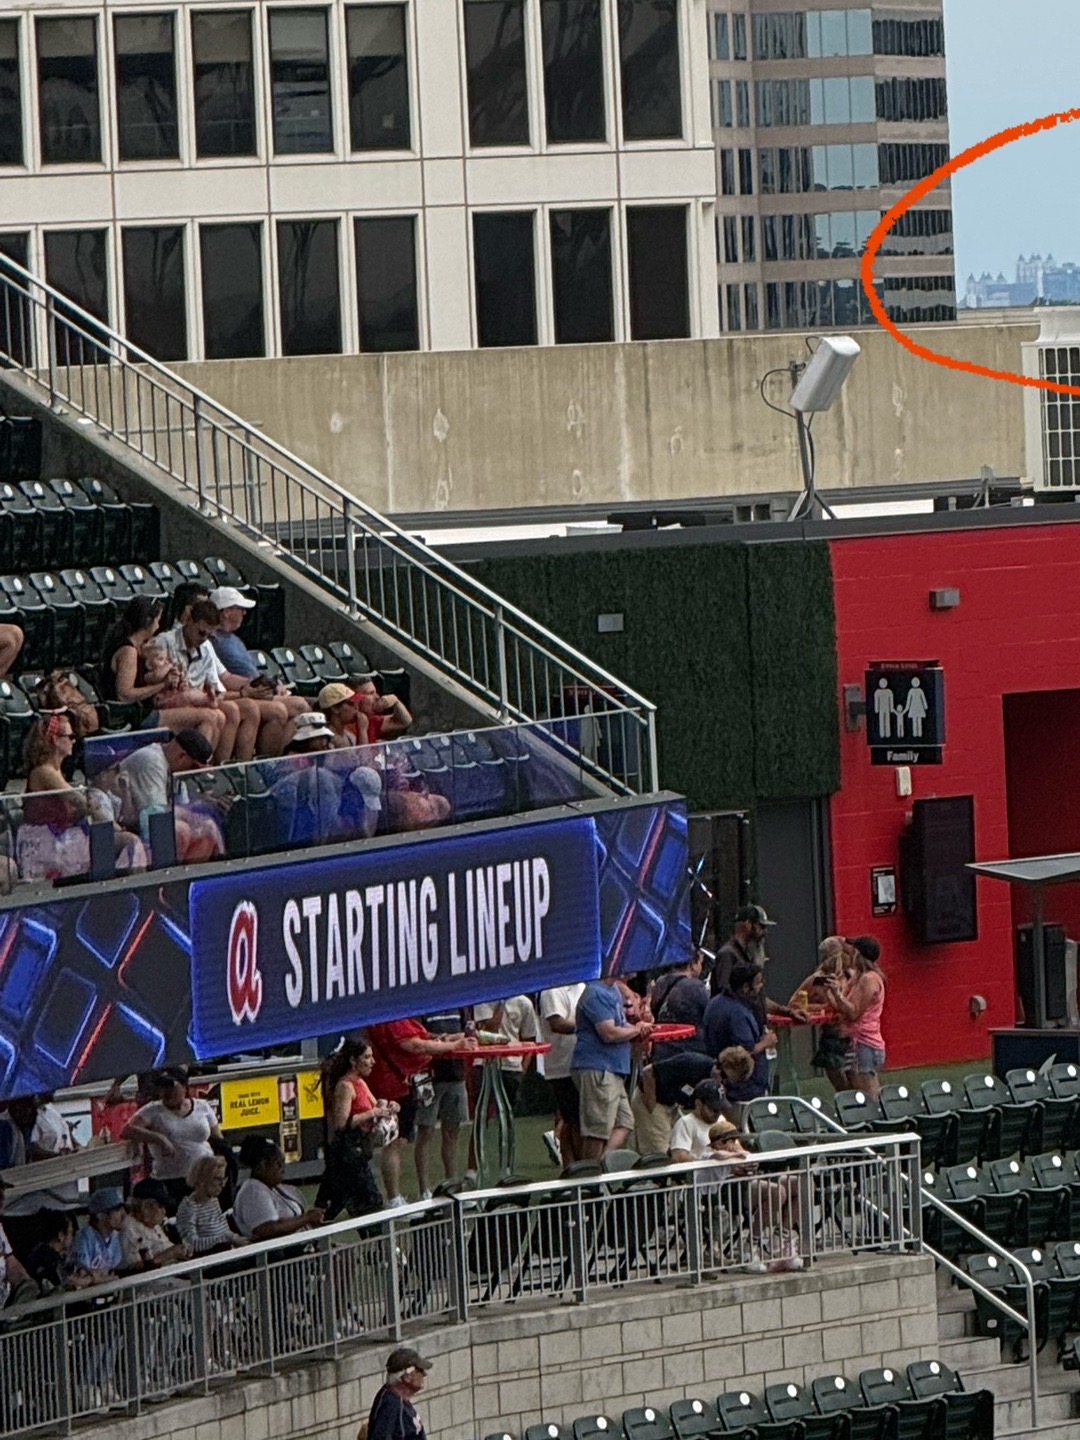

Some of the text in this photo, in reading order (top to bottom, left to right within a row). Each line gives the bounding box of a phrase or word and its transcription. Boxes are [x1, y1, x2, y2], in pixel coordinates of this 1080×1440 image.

[886, 750, 920, 763] Family
[283, 857, 550, 1008] STARTING LINEUP
